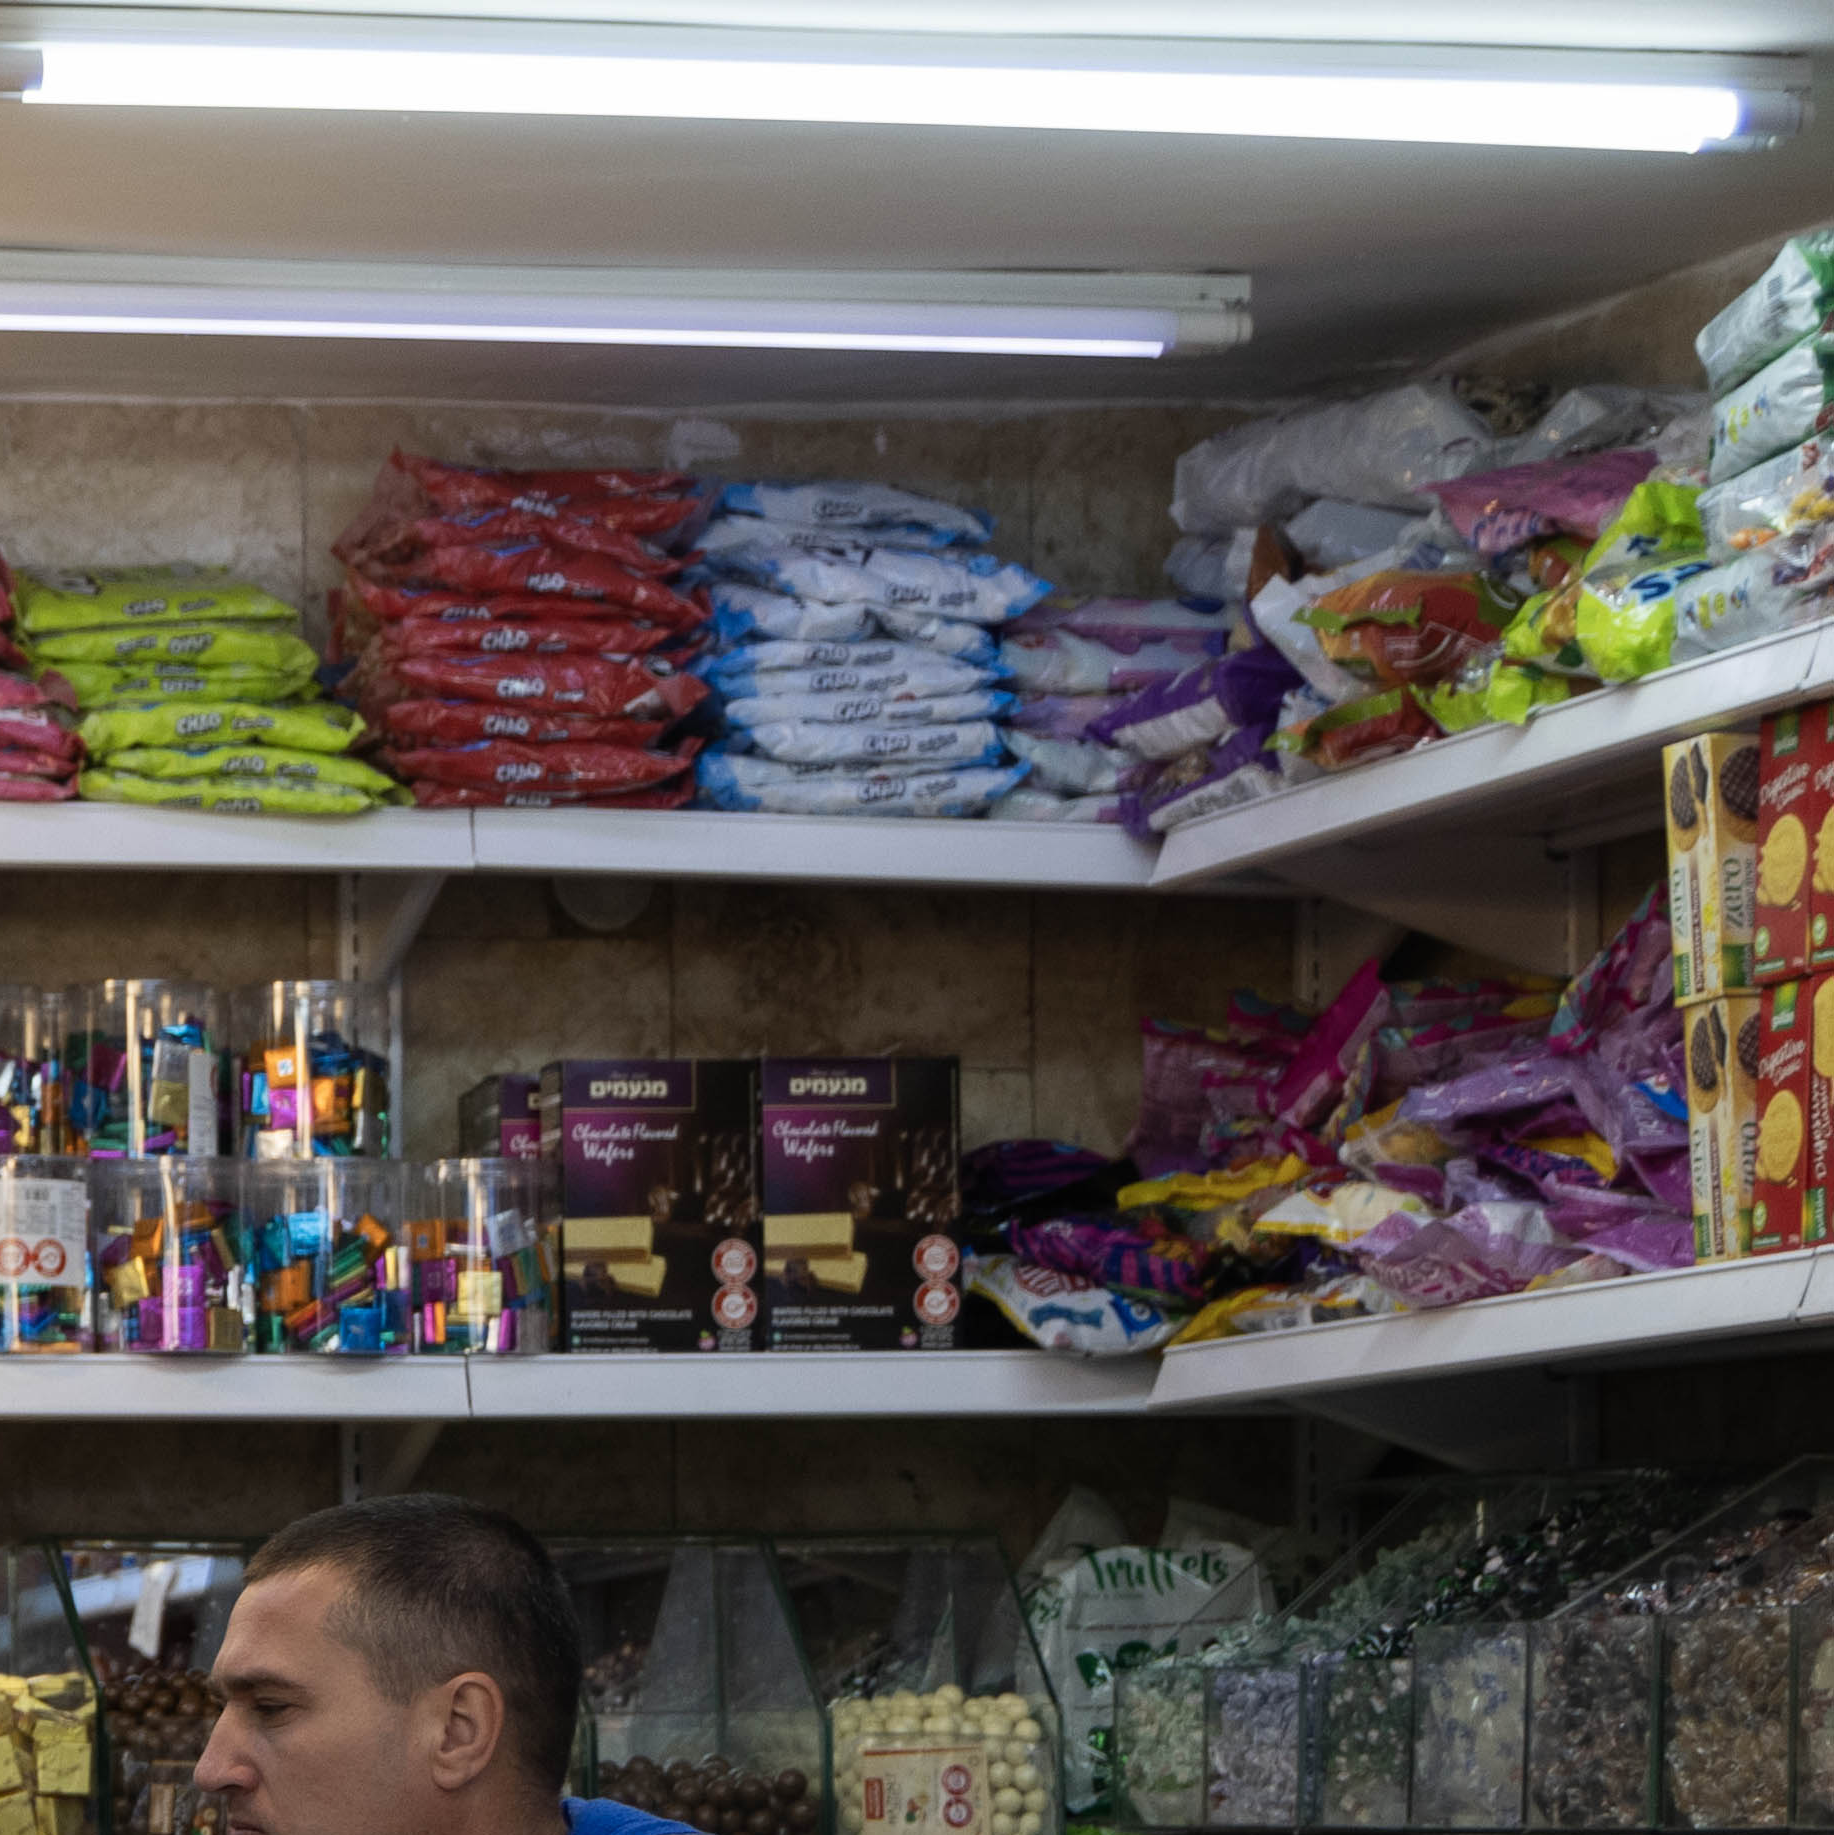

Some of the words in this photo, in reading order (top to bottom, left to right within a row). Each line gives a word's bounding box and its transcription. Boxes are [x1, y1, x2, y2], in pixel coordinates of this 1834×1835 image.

[496, 676, 545, 697] CHAO
[1723, 857, 1744, 930] zero
[590, 1079, 669, 1099] מנעמים
[789, 1077, 868, 1097] מנעמים
[571, 1123, 633, 1141] Chocolate
[772, 1120, 831, 1138] Chocolate
[582, 1143, 635, 1168] Wafers
[782, 1138, 835, 1164] Wafers
